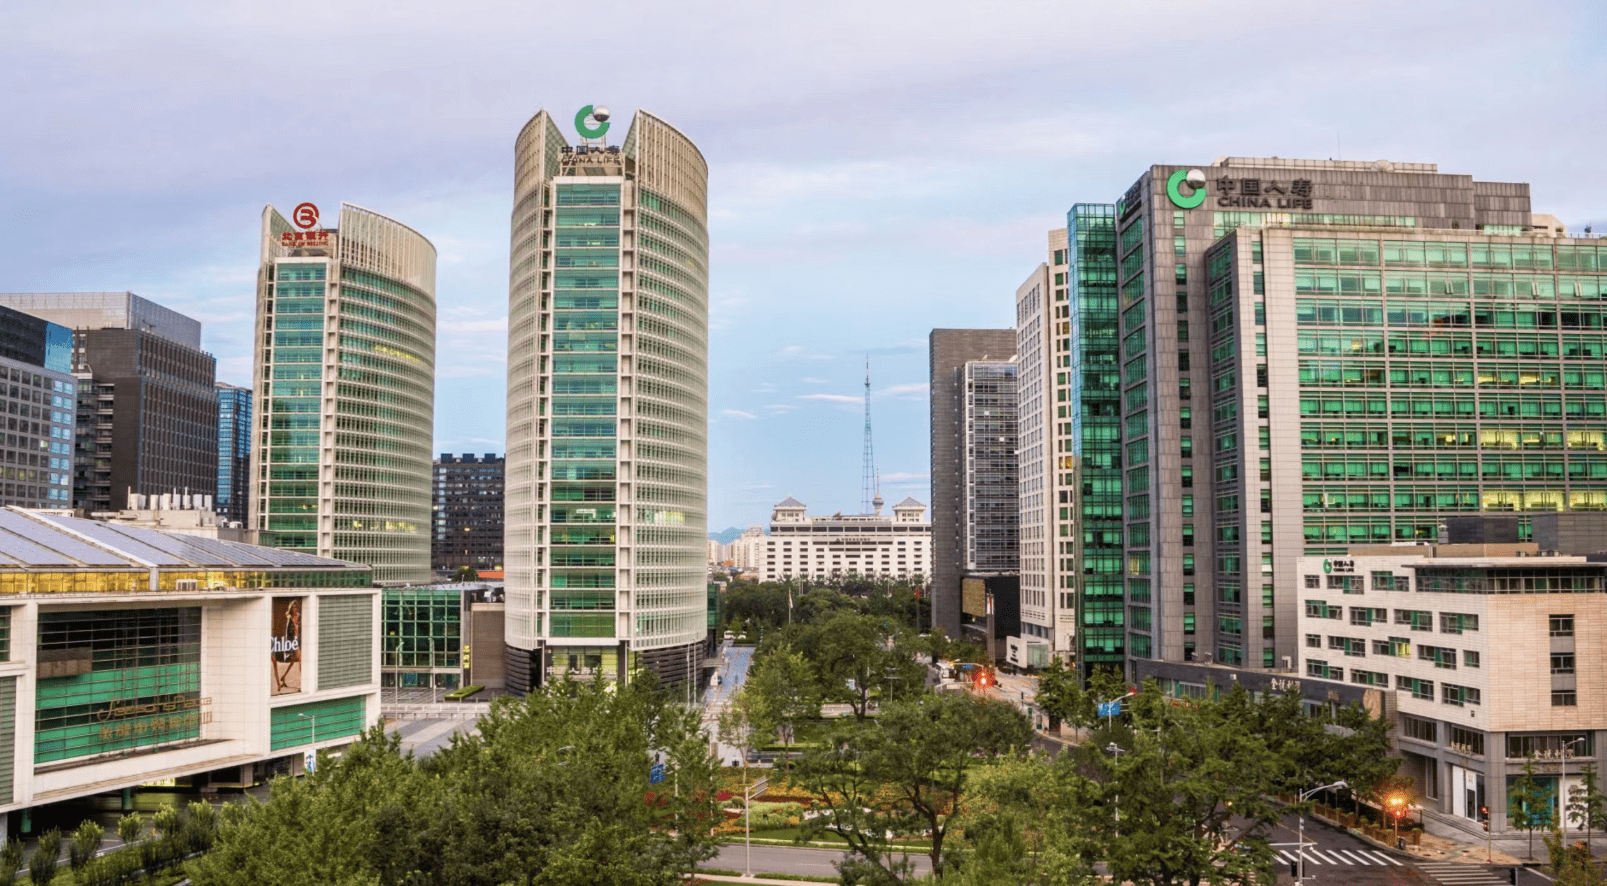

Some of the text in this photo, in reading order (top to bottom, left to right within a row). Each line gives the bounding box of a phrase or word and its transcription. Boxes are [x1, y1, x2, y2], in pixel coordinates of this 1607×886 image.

[561, 145, 620, 156] 中国人寿
[1216, 175, 1313, 197] 中国人寿
[1217, 196, 1313, 209] CHINA LIFE
